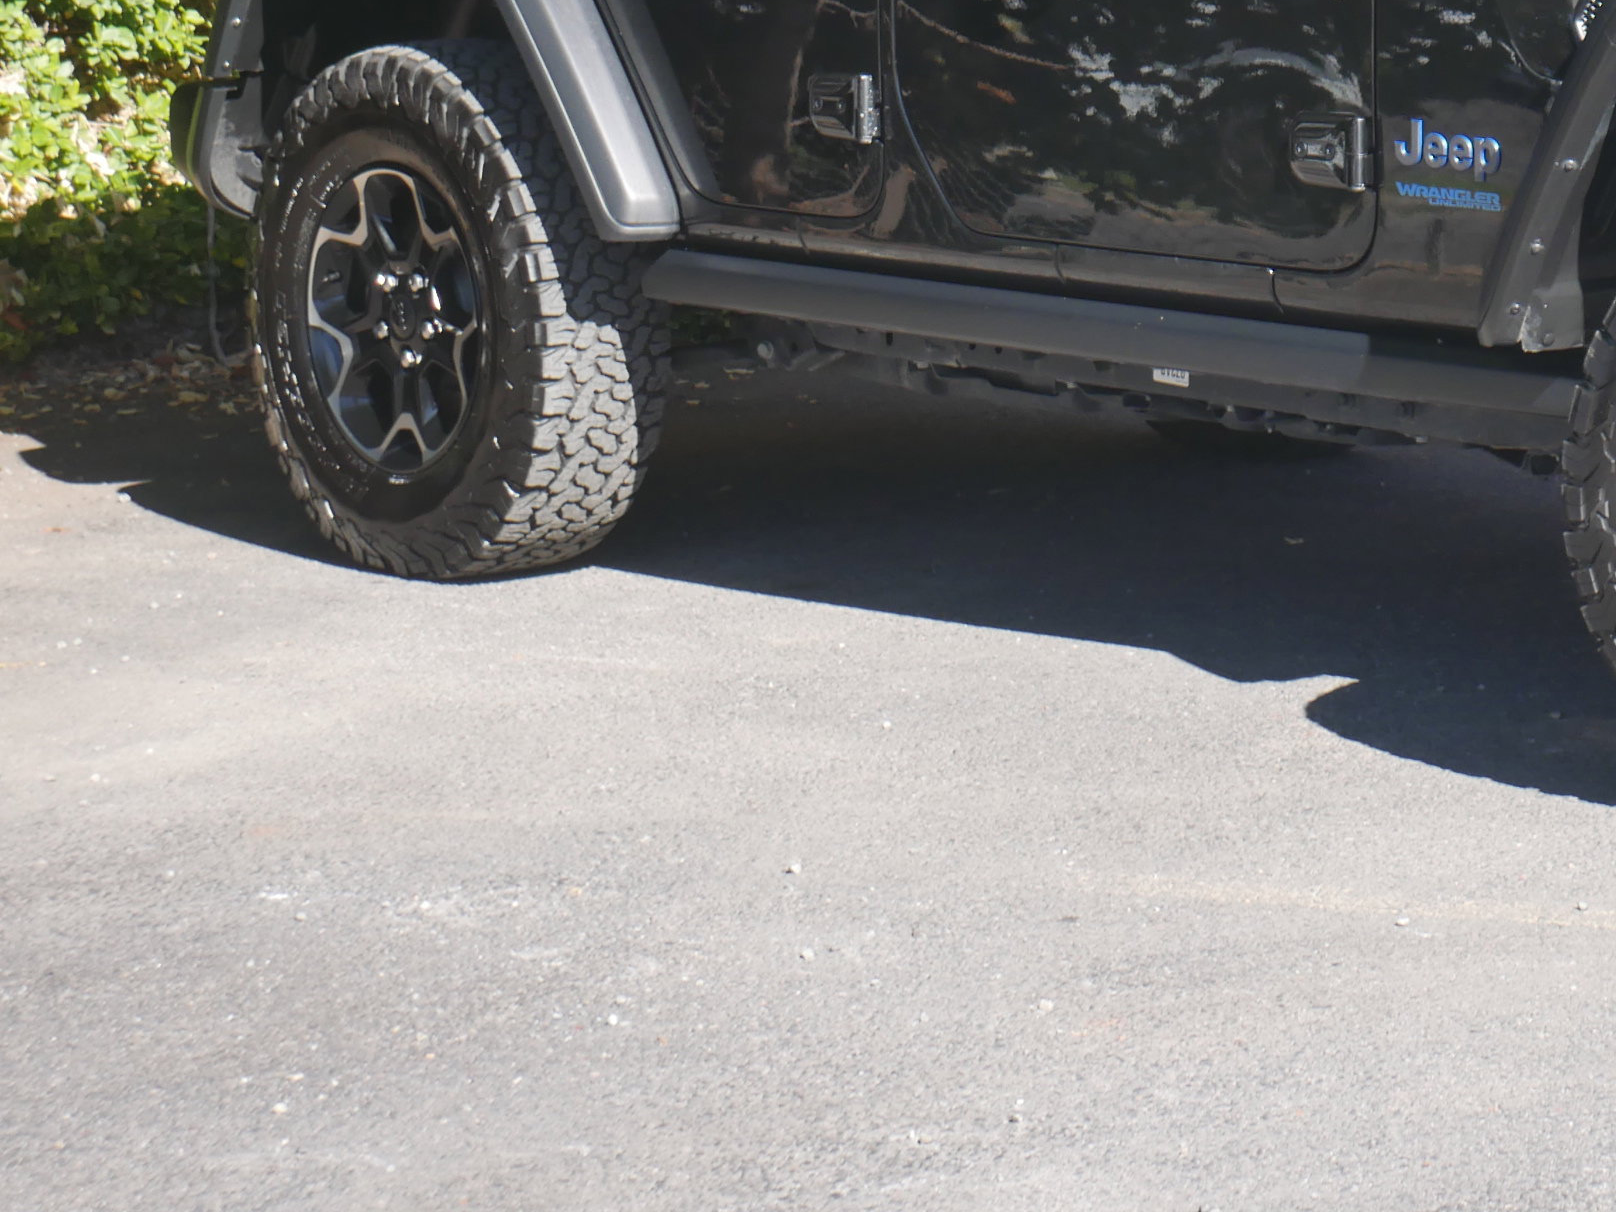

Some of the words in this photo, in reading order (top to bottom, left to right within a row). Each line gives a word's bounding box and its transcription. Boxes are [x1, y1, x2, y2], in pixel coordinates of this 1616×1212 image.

[1394, 118, 1502, 182] Jeep
[1395, 181, 1500, 205] WRANGLER
[1428, 197, 1503, 212] UNLIMITED
